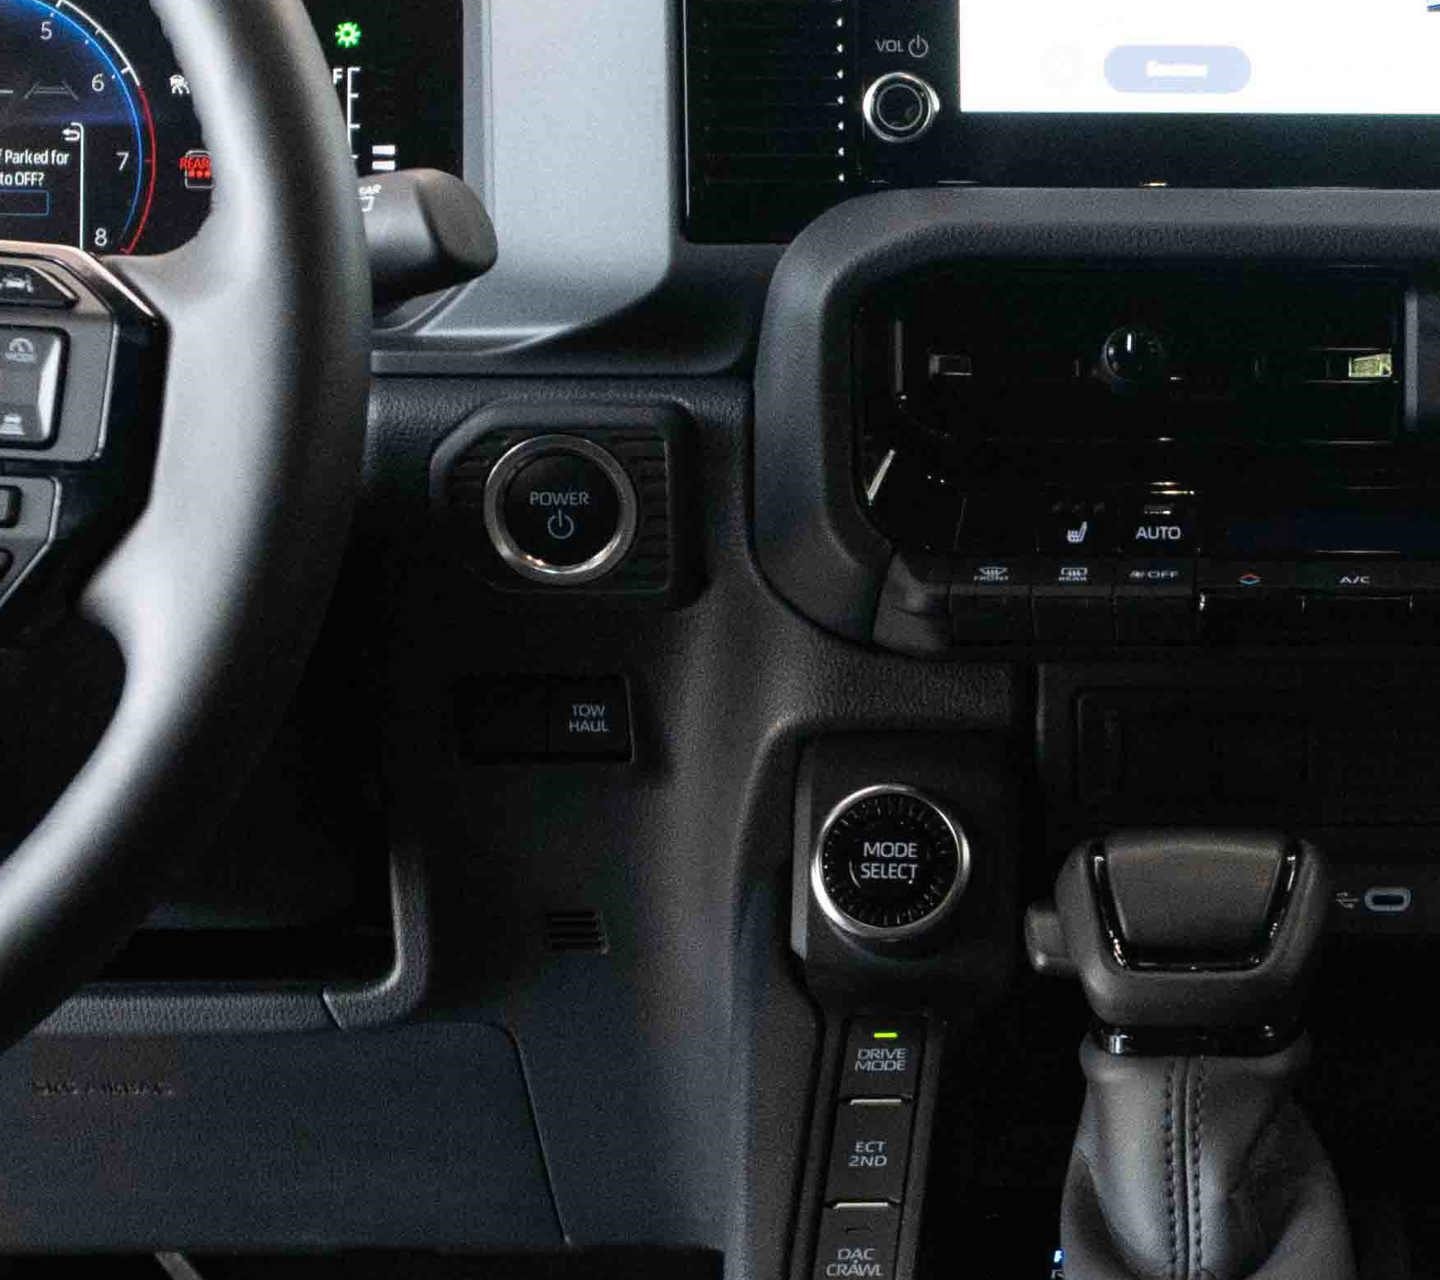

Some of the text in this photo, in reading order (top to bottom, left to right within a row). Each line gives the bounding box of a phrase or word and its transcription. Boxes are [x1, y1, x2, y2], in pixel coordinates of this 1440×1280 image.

[39, 21, 53, 40] 5
[874, 39, 904, 52] VOL
[91, 73, 105, 92] 6
[5, 149, 49, 166] Parked
[51, 149, 70, 166] for
[116, 152, 129, 171] 7
[15, 171, 45, 187] OFF?
[93, 228, 108, 247] 8
[529, 490, 590, 506] POWER
[1135, 525, 1182, 540] AUTO
[1146, 570, 1179, 579] OFF
[1339, 575, 1371, 585] A/C
[572, 704, 606, 718] TOW
[569, 719, 609, 733] HAUL
[863, 841, 919, 858] MODE
[860, 863, 918, 879] SELECT
[857, 1047, 908, 1060] DRIVE
[854, 1060, 905, 1072] MODE
[855, 1140, 888, 1153] ECT
[848, 1155, 888, 1167] 2ND
[837, 1247, 877, 1261] DAC
[825, 1263, 885, 1277] CRAWL
